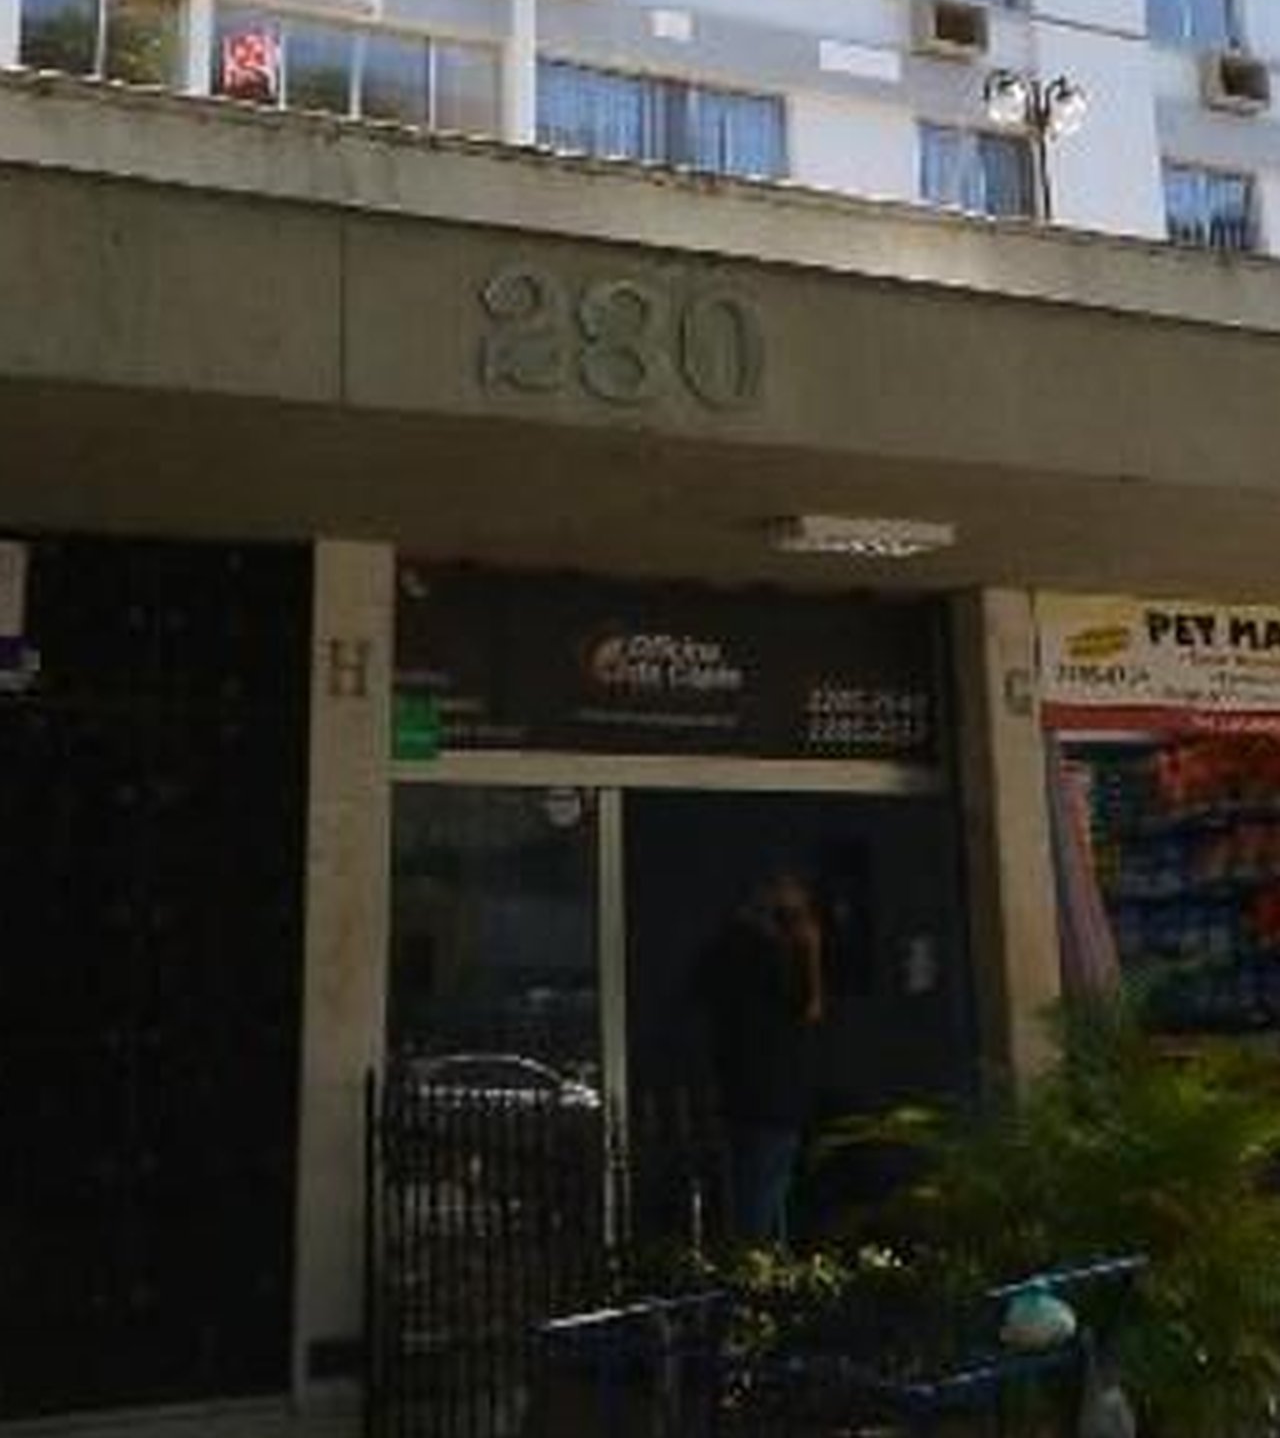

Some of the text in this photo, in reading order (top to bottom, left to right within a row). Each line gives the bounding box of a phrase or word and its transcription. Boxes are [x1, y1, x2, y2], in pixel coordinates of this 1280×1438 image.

[476, 269, 764, 414] 280
[1144, 610, 1217, 647] PET
[324, 639, 370, 699] H
